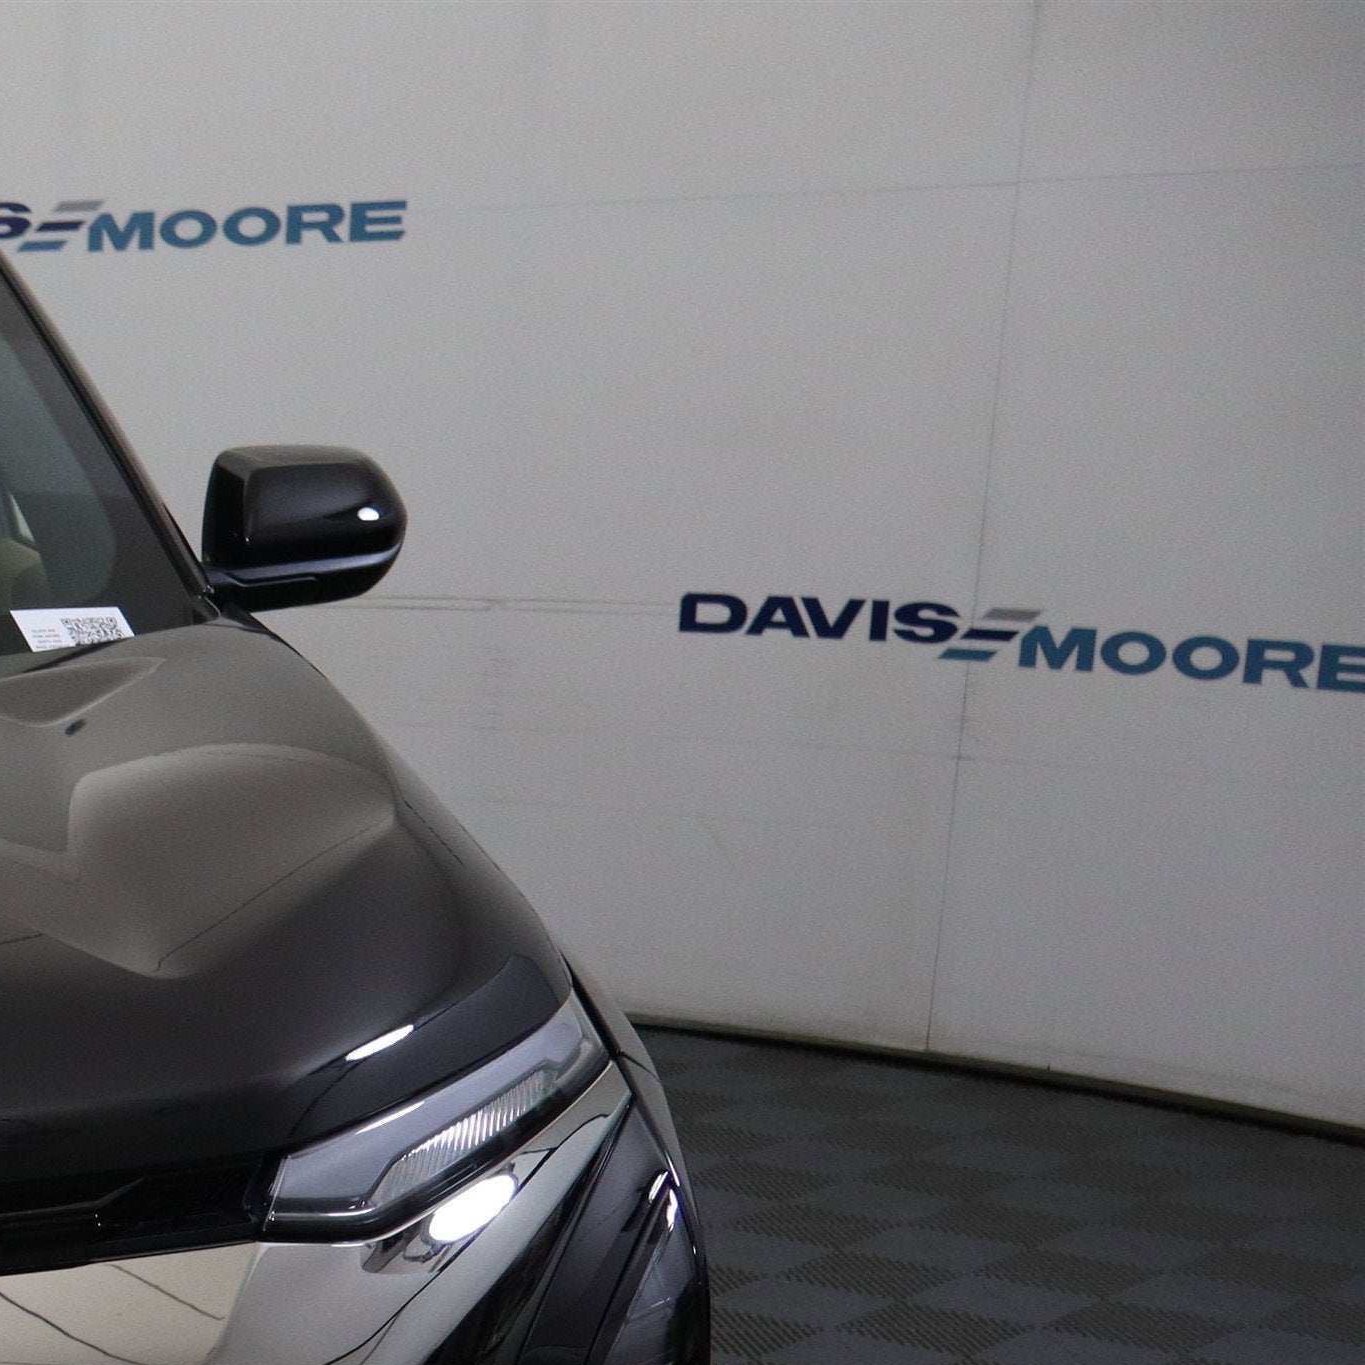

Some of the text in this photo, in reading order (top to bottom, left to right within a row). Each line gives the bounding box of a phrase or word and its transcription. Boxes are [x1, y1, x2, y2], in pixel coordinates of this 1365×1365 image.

[86, 200, 408, 255] MOORE
[677, 592, 1365, 695] DAVIS MOORE
